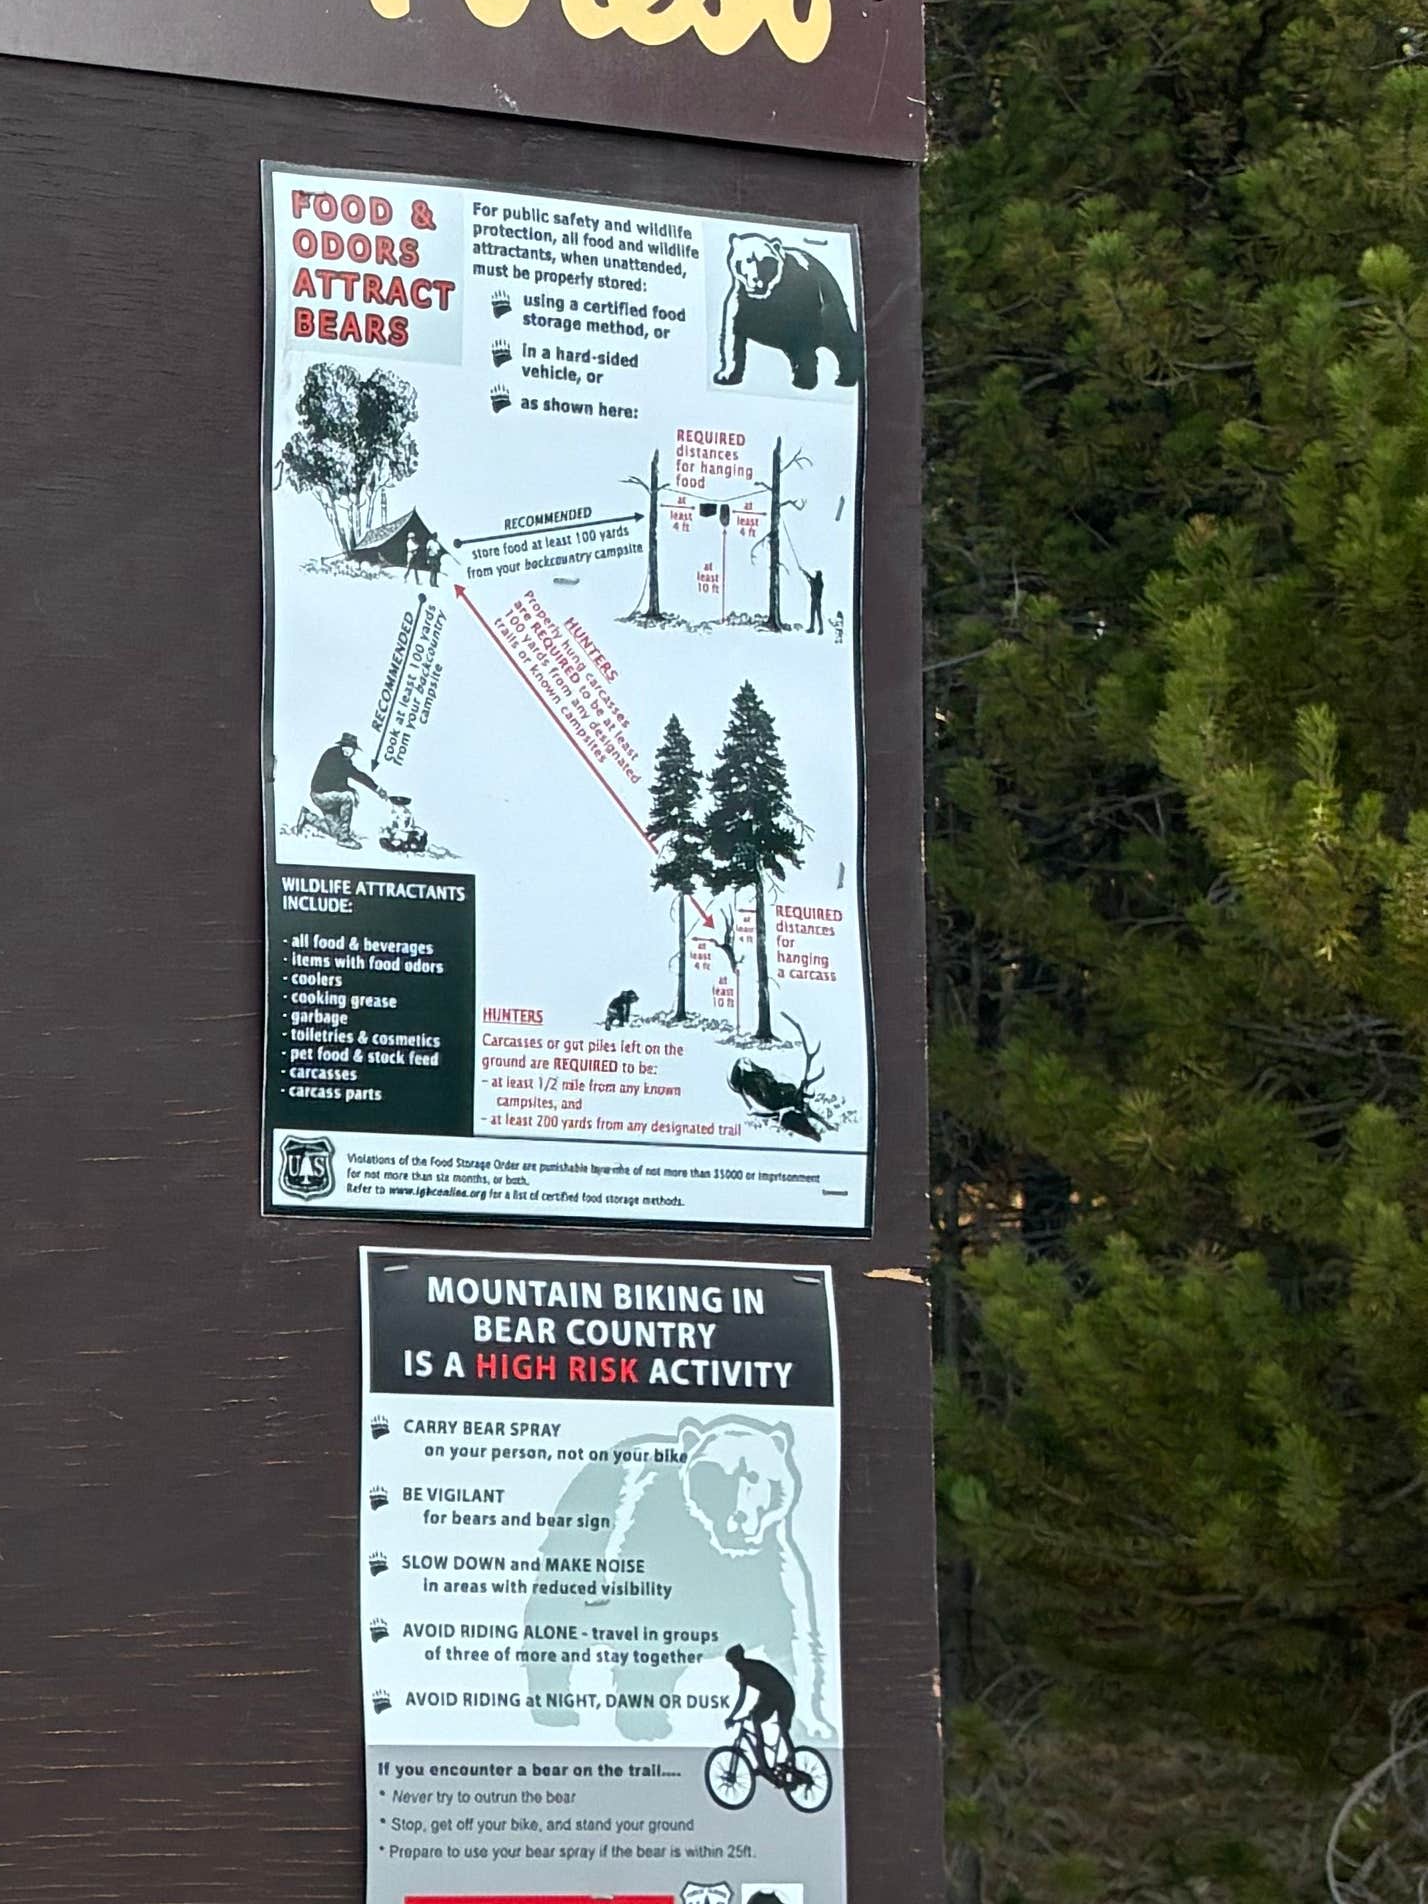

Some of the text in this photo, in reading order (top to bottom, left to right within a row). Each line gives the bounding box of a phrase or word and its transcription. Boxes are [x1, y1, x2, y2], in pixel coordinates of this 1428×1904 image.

[291, 189, 437, 231] FOOD &
[473, 202, 692, 240] For public safety and wildlife
[292, 228, 420, 269] ODORS
[292, 267, 456, 311] ATTRACT
[294, 306, 409, 347] BEARS
[504, 506, 592, 530] RECOMMENDED
[282, 876, 466, 901] WILDLIFE ATTRACTANTS
[283, 895, 353, 913] INCLUDE:
[291, 933, 434, 957] all food & beverages
[483, 1007, 543, 1026] HUNTERS
[428, 1276, 764, 1314] MOUNTAIN BIKING IN
[474, 1315, 716, 1349] BEAR COUNTRY
[405, 1350, 793, 1388] IS A HIGH RISK ACTIVITY
[403, 1419, 561, 1437] CARRY BEAR SPRAY
[402, 1555, 645, 1573] SLOW DOWN and MAKE NOISE
[391, 1817, 694, 1835] Stop, get off your bike, and stand your ground
